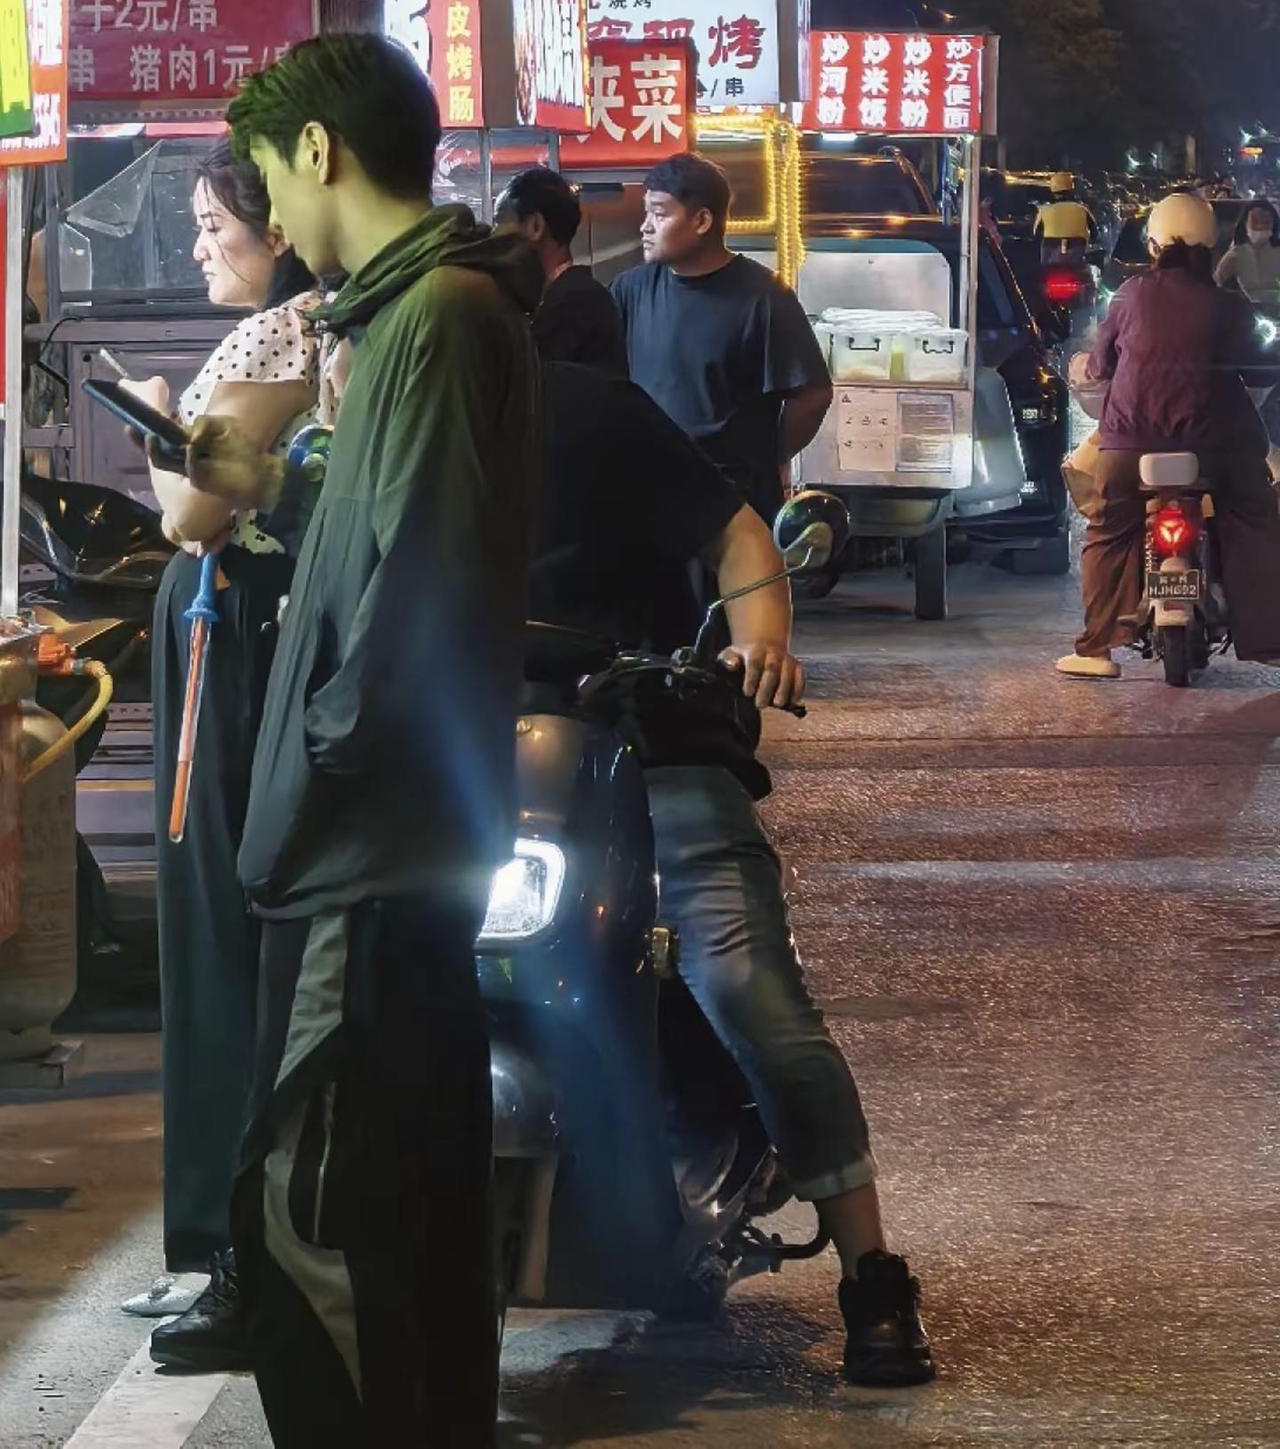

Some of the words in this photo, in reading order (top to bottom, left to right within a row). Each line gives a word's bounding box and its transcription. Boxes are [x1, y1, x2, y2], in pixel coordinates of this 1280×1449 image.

[817, 33, 850, 125] 炒河粉
[858, 34, 891, 127] 炒米饭
[901, 36, 932, 128] 炒米粉
[944, 39, 973, 129] 炒方便面
